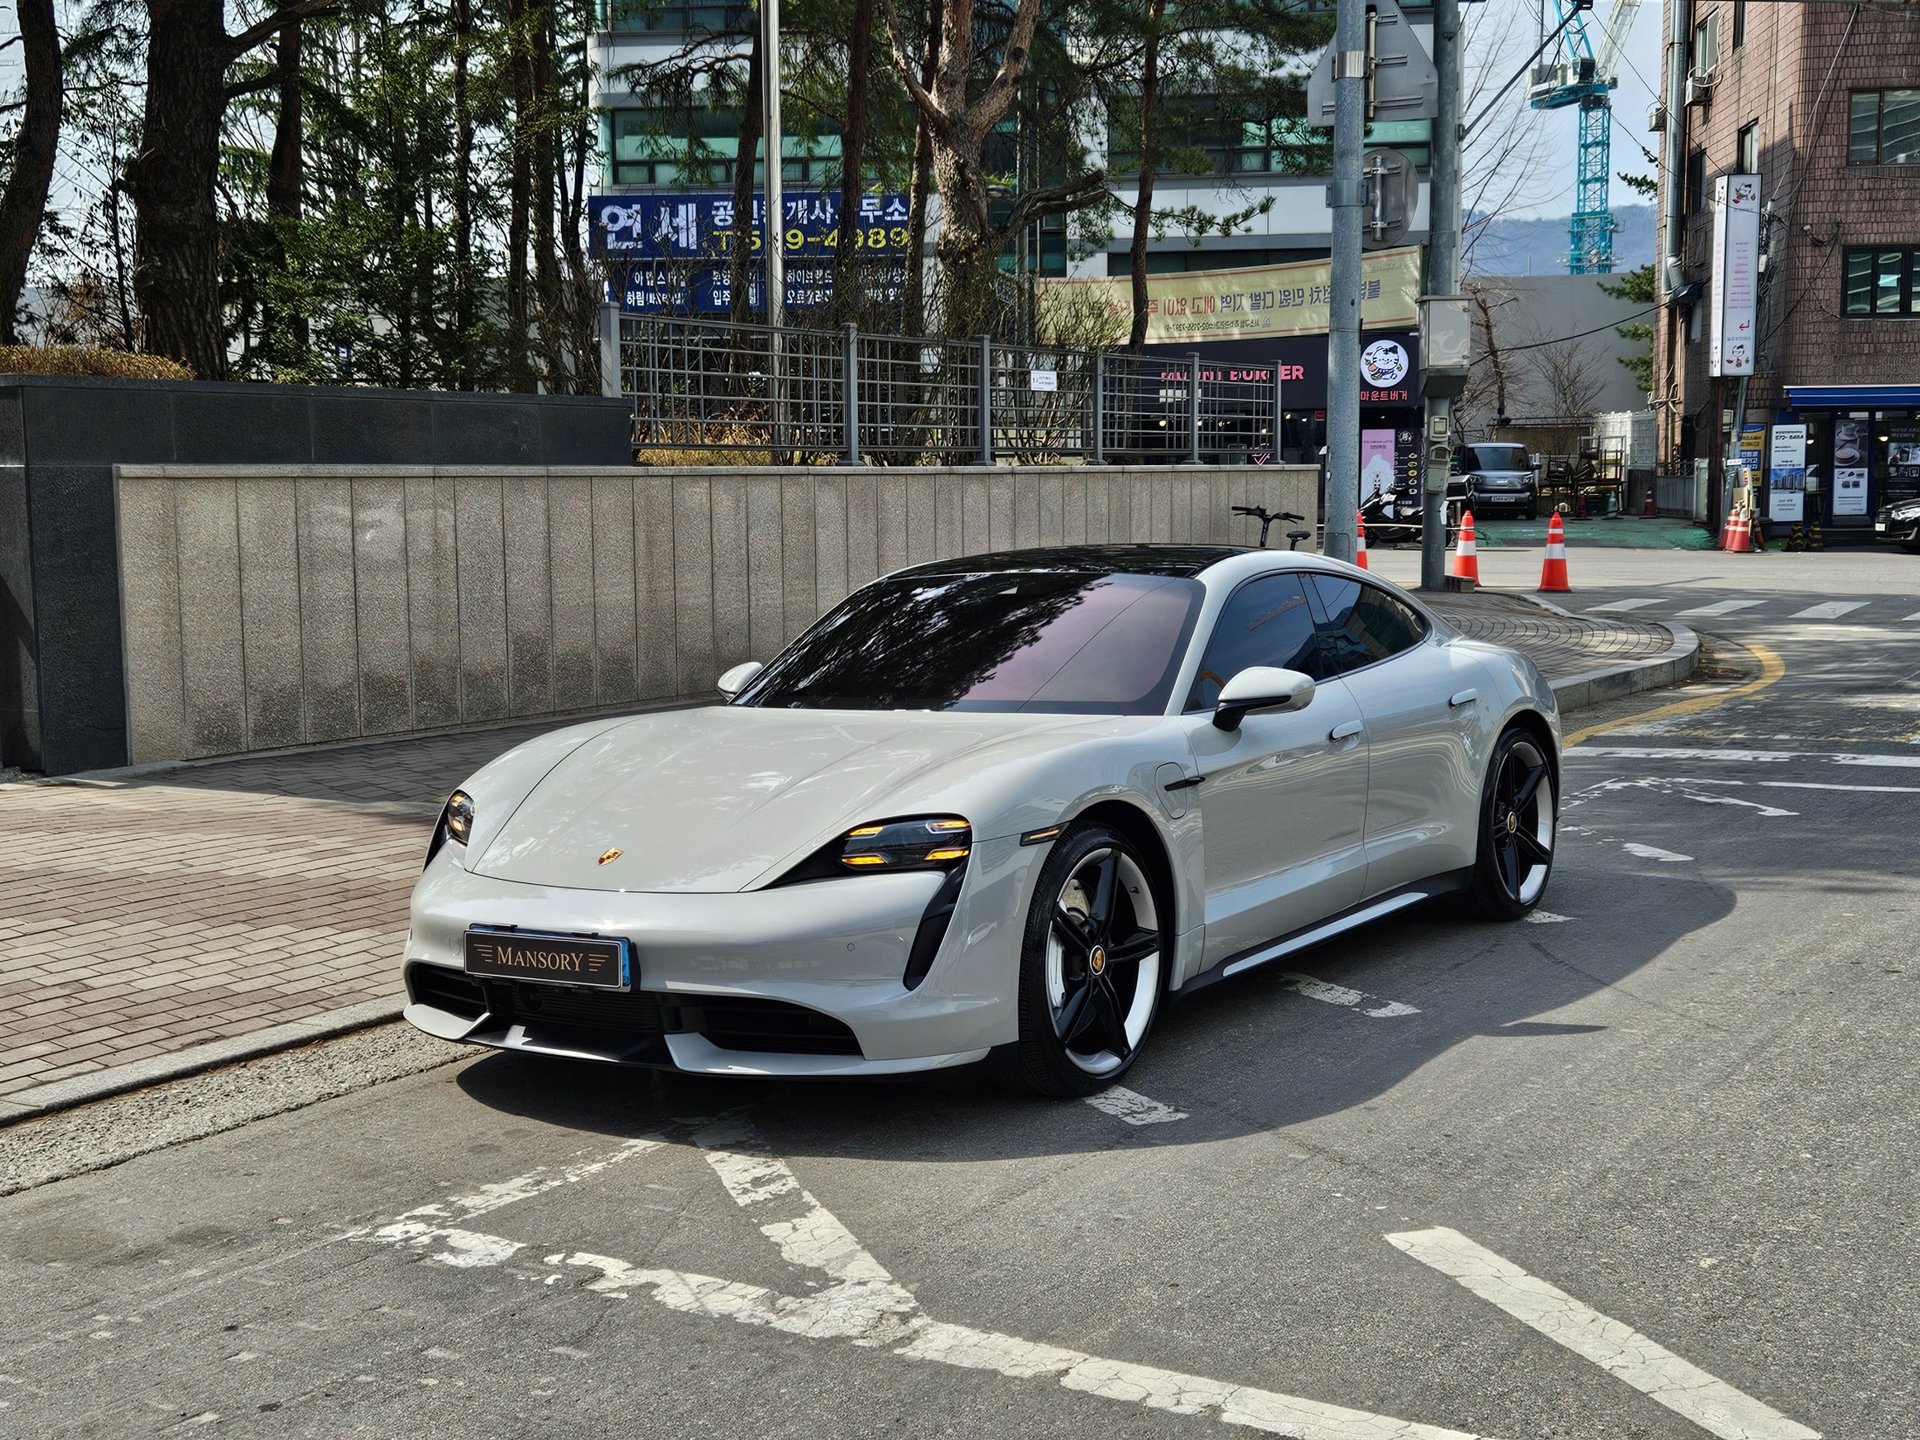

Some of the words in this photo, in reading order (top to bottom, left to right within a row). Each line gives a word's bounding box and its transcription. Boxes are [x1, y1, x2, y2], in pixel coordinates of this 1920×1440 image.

[601, 203, 697, 249] 연세
[1360, 391, 1408, 401] 마운트버거
[497, 946, 584, 972] MANSORY
